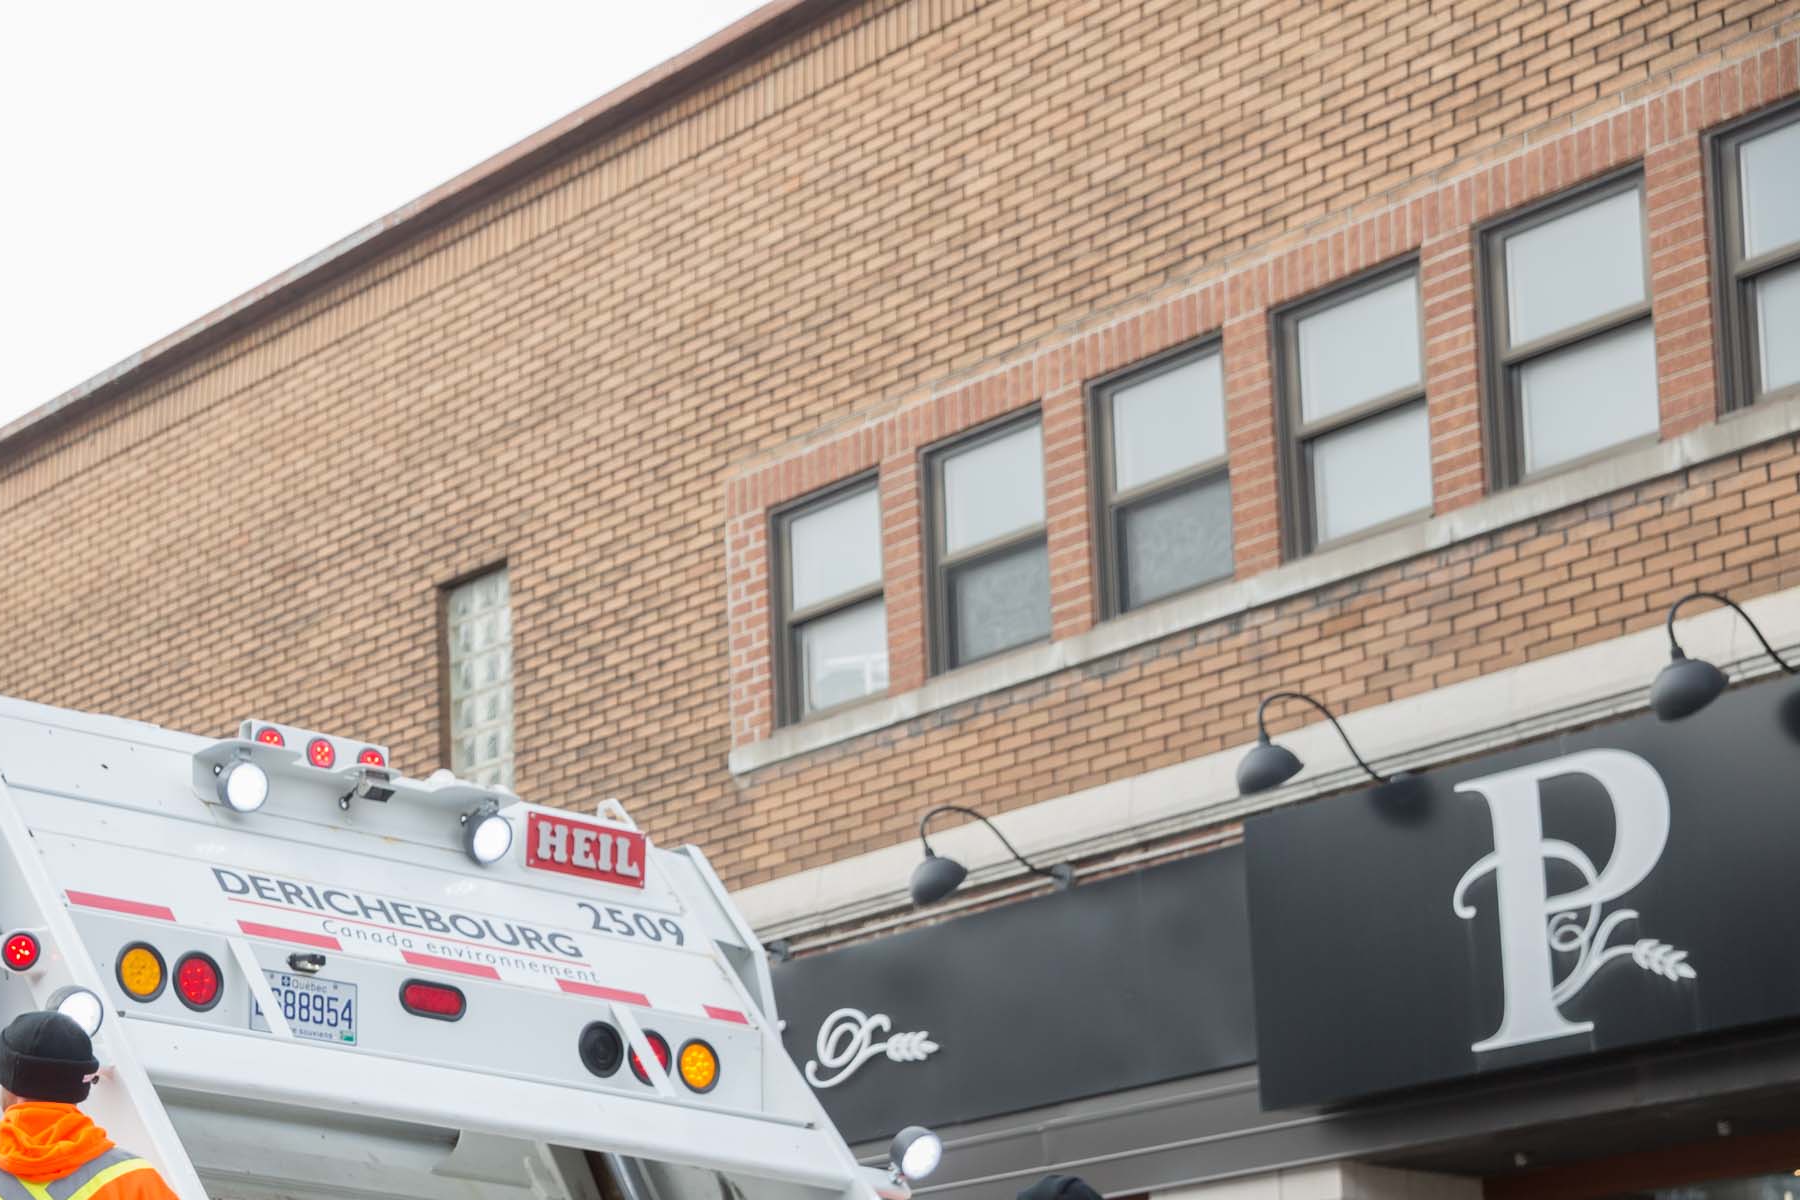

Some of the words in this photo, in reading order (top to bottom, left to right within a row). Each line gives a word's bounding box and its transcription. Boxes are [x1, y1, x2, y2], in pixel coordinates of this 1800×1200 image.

[536, 820, 641, 879] HEIL
[211, 866, 584, 959] DERICHEBOURG
[576, 902, 685, 947] 2509
[1453, 748, 1671, 1052] P
[321, 918, 414, 950] Canada
[426, 941, 601, 984] environnement
